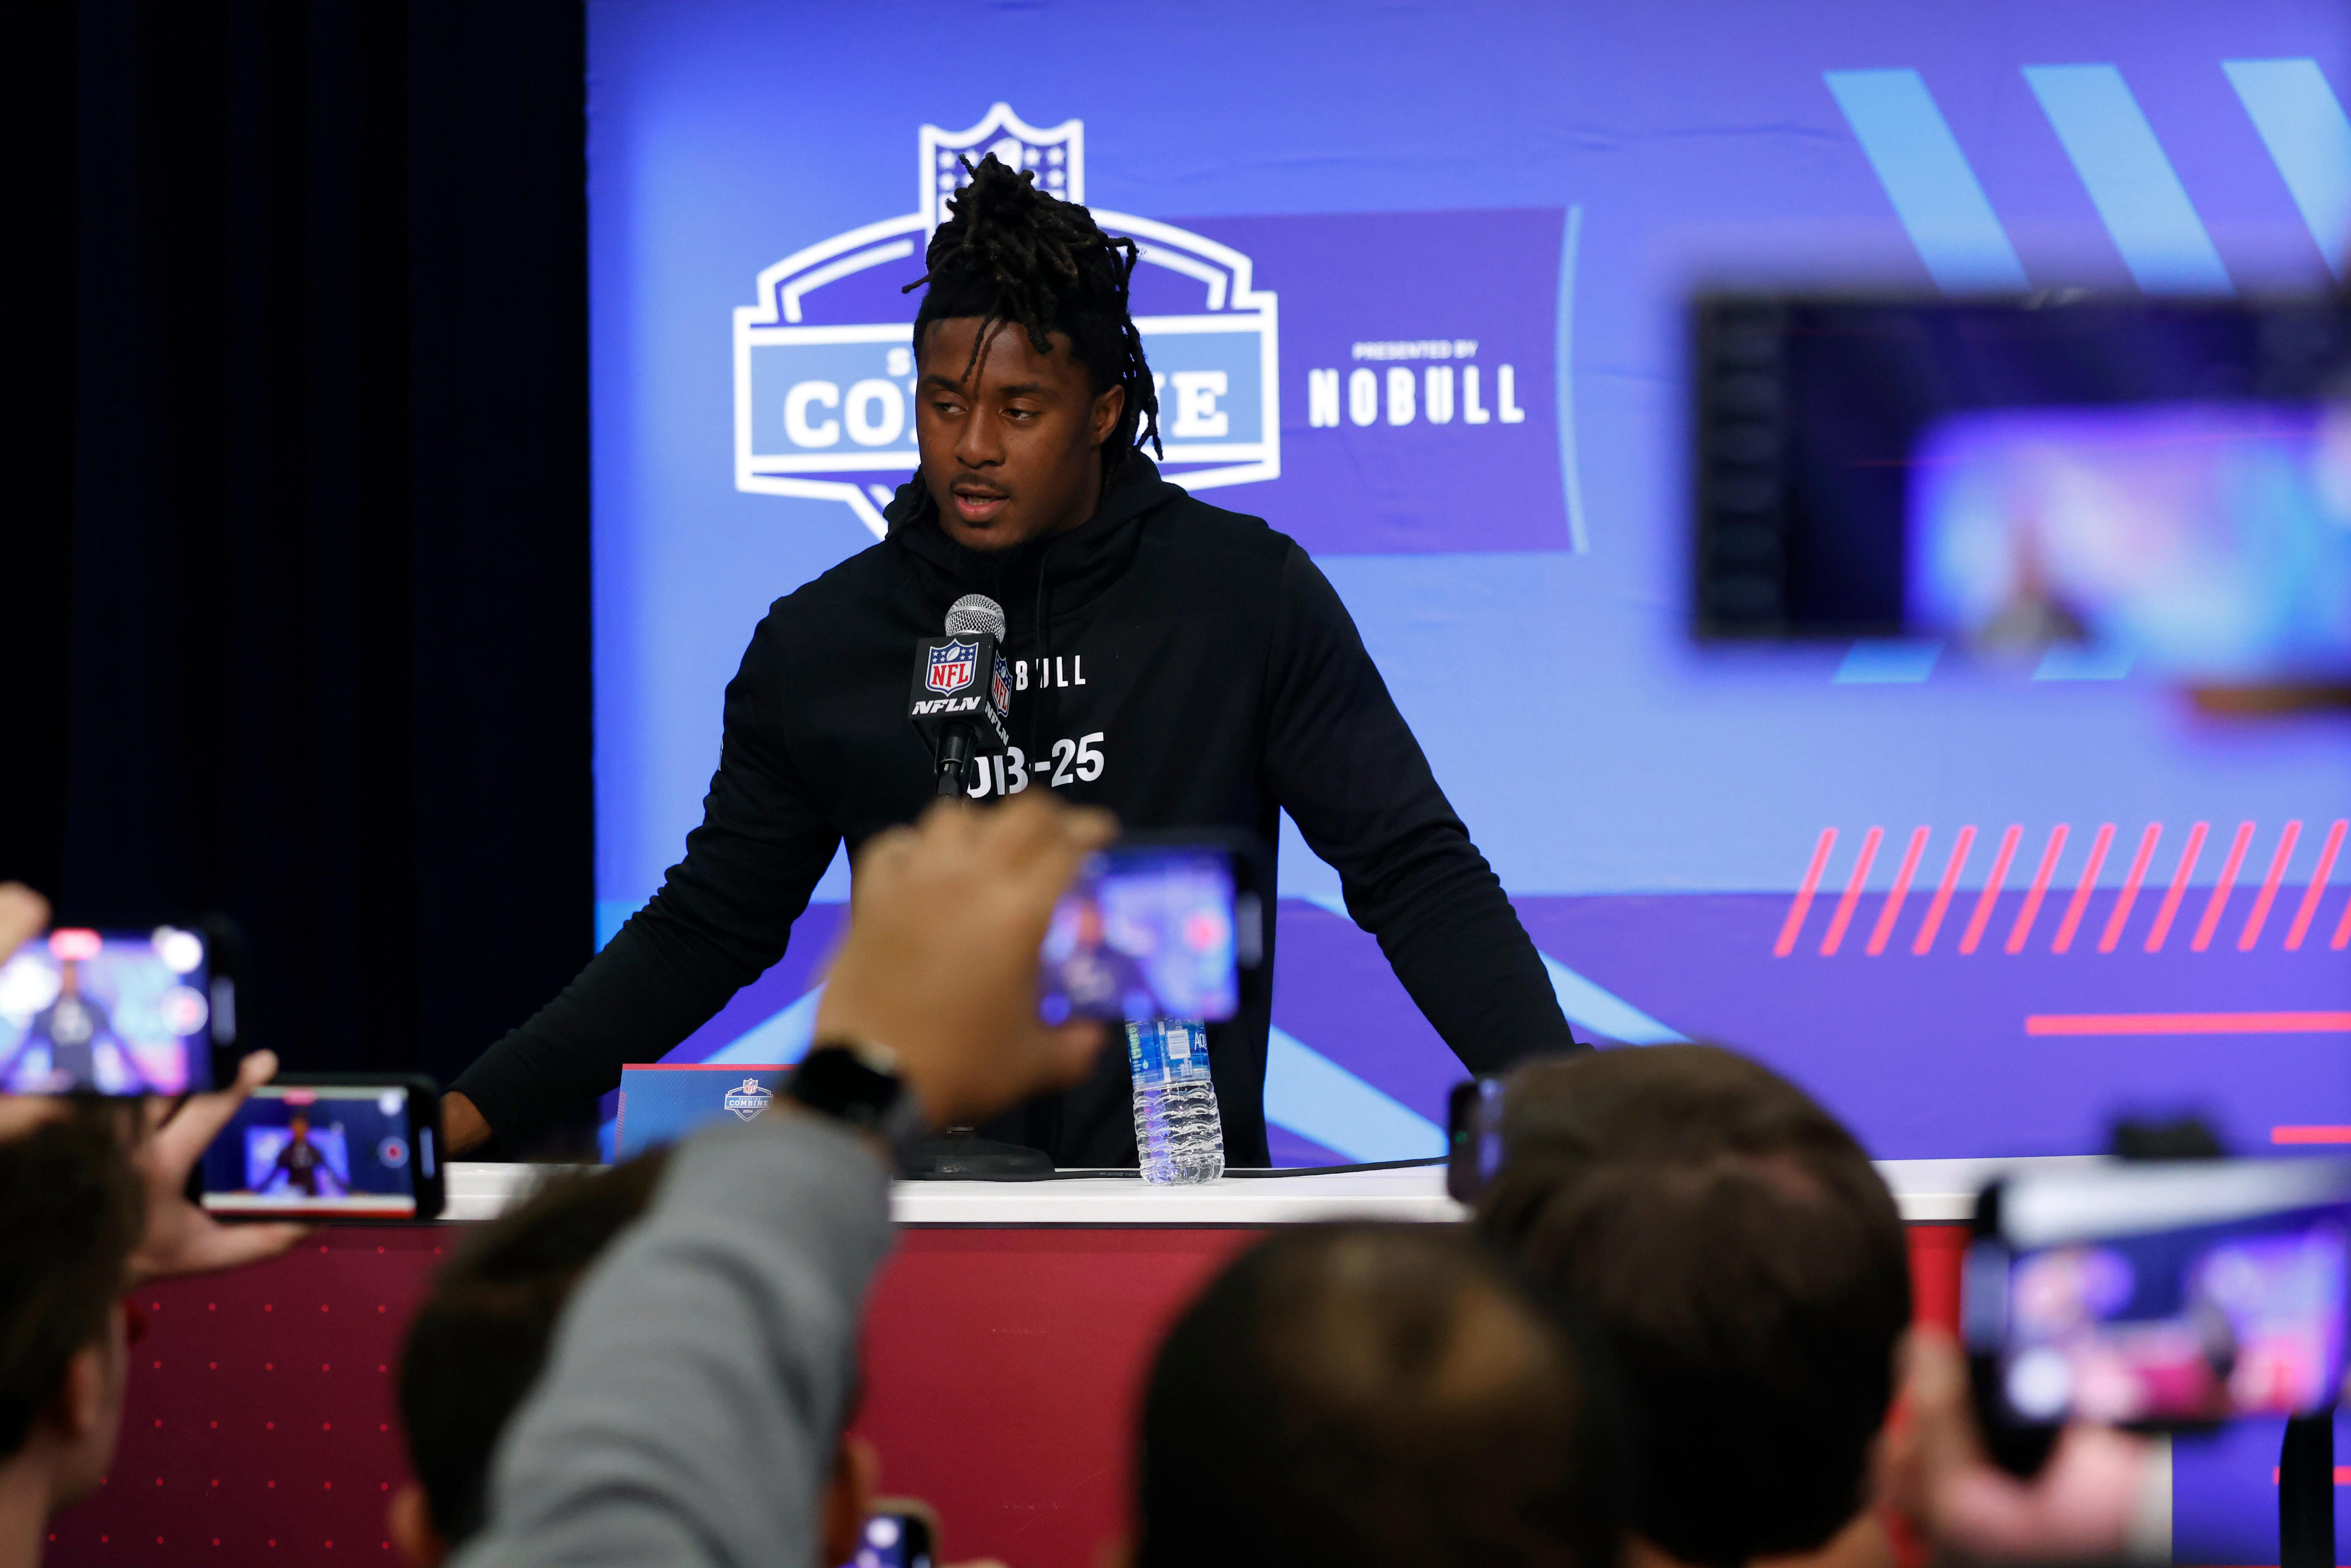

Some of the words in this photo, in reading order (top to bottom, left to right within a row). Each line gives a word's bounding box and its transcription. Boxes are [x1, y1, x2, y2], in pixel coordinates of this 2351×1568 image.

[1351, 340, 1452, 361] PRESENTED
[1453, 339, 1479, 359] BY
[1308, 363, 1525, 428] NOBULL
[931, 663, 969, 688] NFL
[1015, 655, 1086, 691] BULL
[912, 696, 981, 715] NFLN
[993, 674, 1008, 710] NFL
[984, 701, 1009, 746] NFLN
